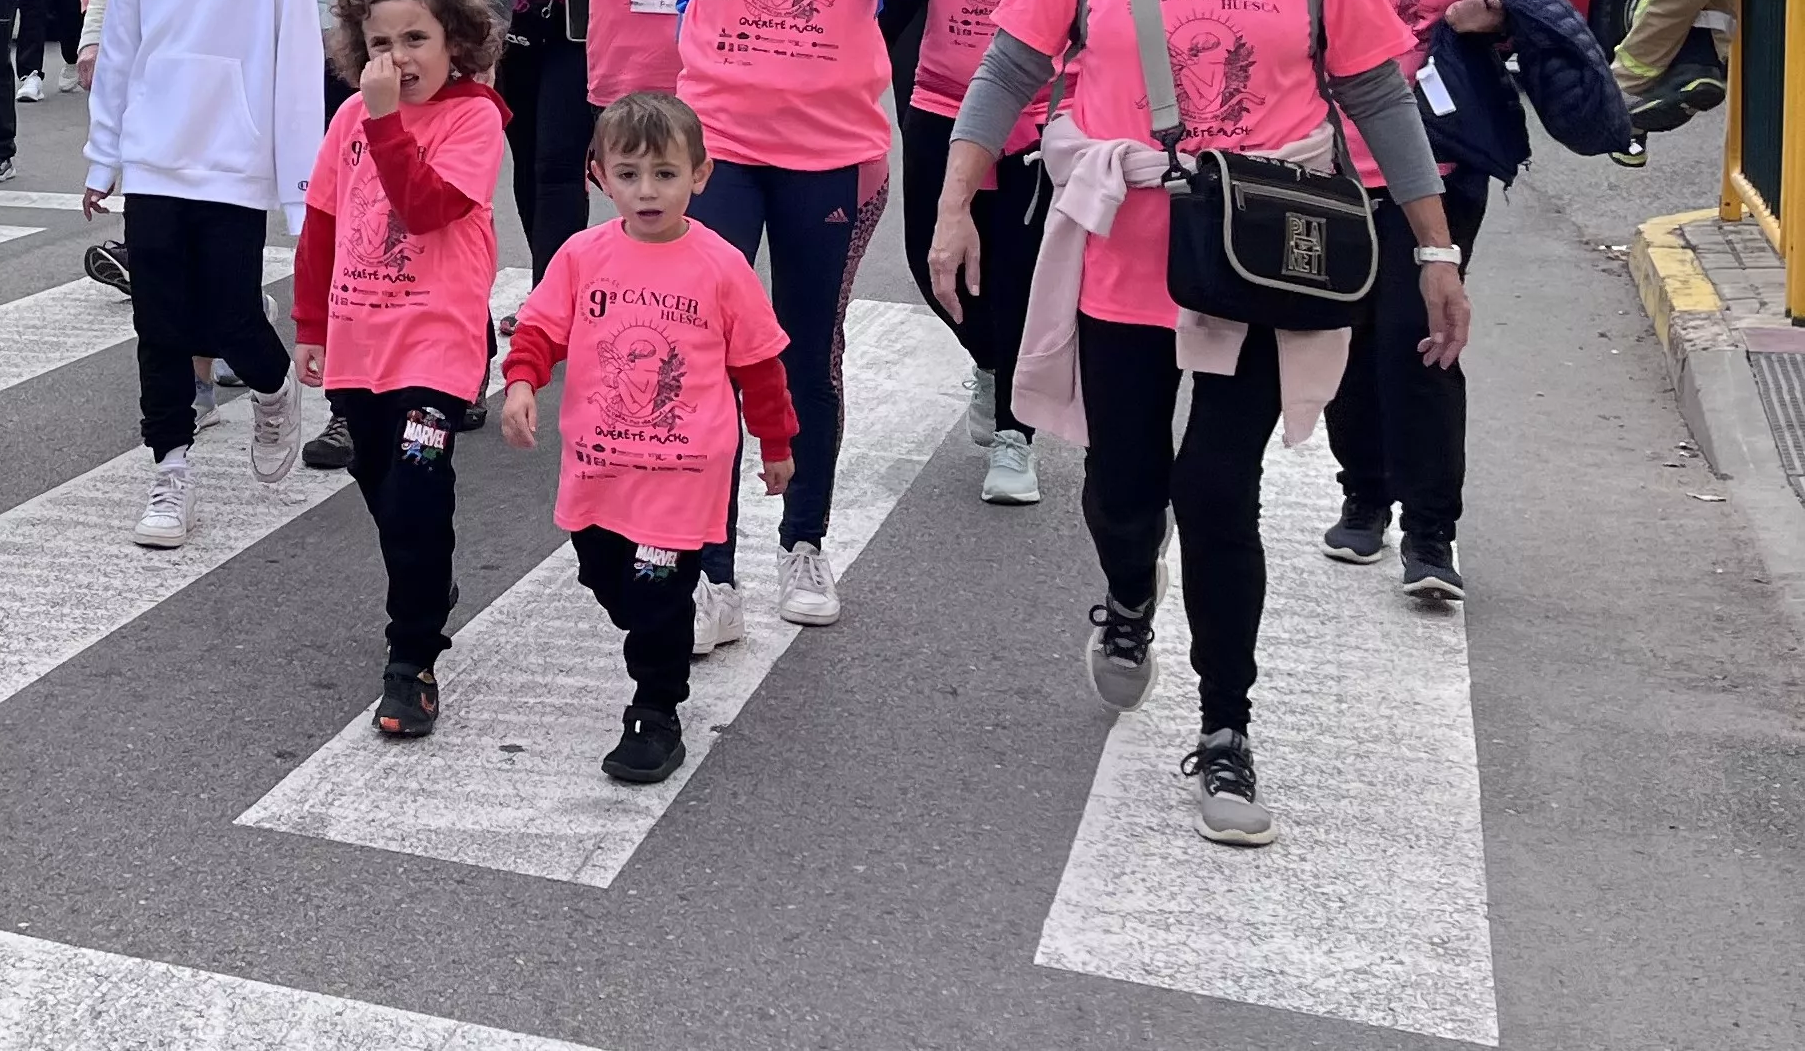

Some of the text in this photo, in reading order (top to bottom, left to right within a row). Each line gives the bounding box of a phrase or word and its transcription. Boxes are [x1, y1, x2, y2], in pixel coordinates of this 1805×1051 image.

[1221, 0, 1281, 14] HUESCA
[589, 289, 617, 318] 9ª
[622, 287, 699, 317] CÁNCER
[659, 309, 709, 330] HUESCA
[648, 433, 690, 446] MUCHO
